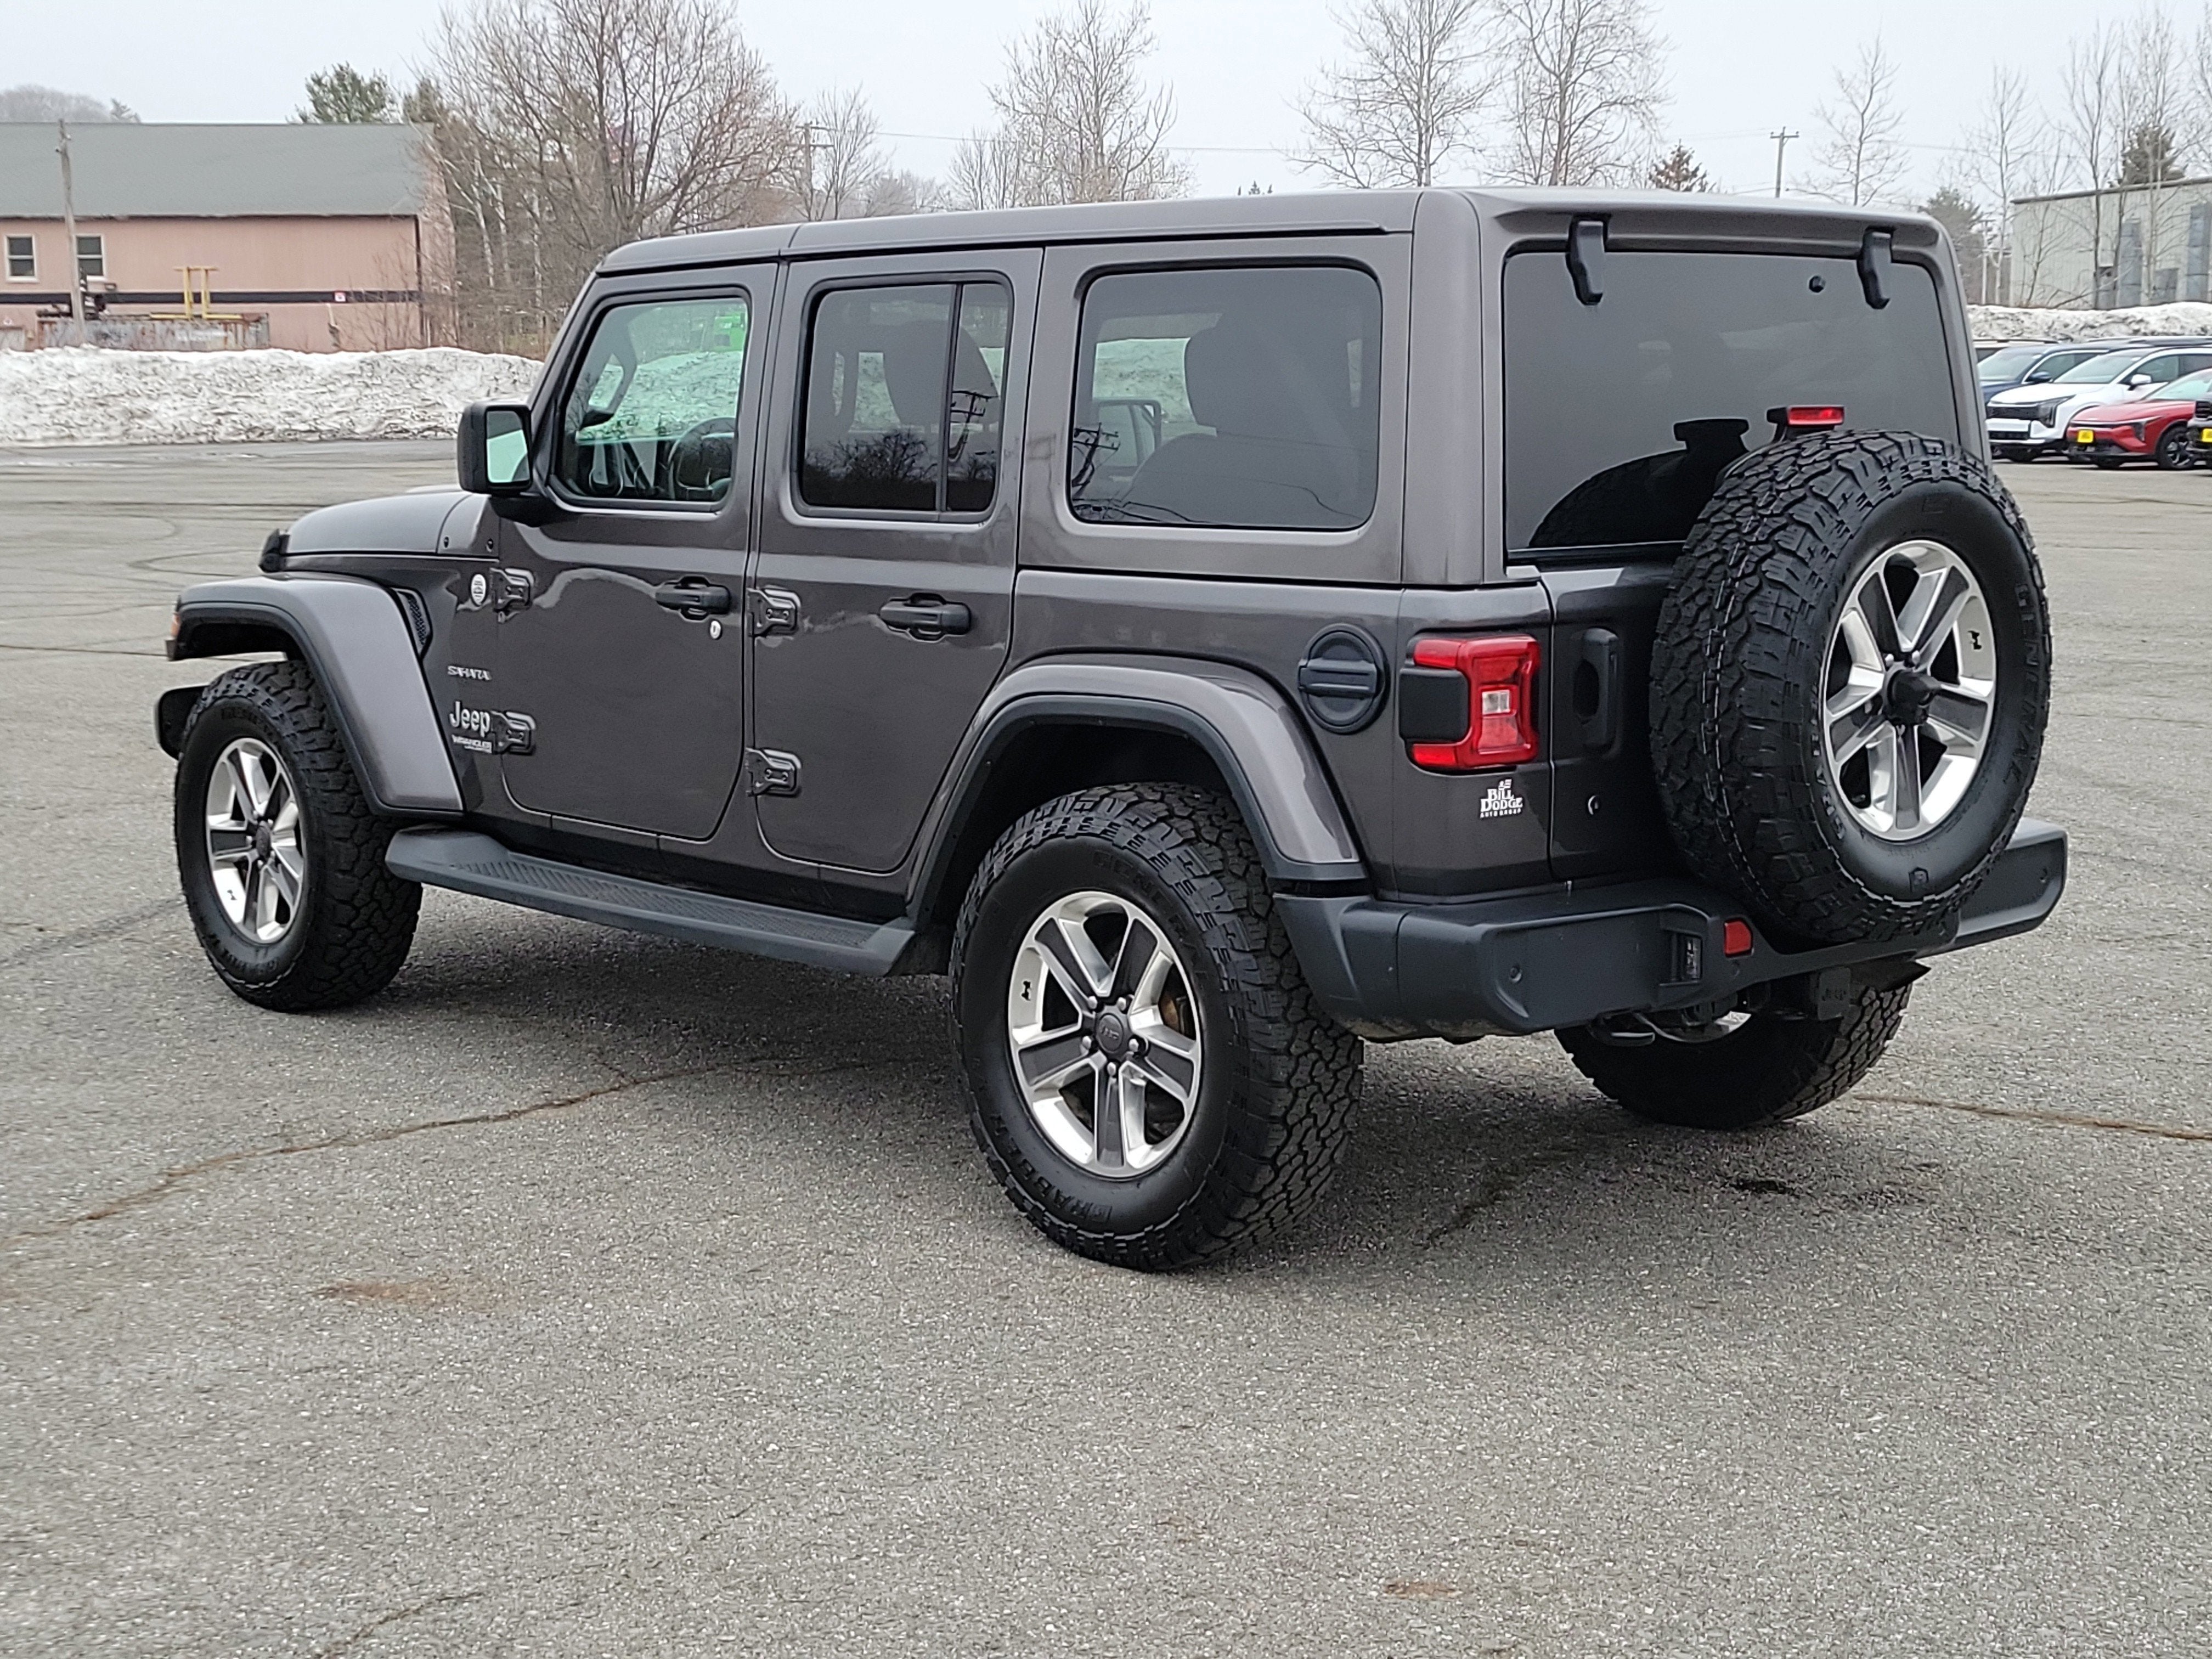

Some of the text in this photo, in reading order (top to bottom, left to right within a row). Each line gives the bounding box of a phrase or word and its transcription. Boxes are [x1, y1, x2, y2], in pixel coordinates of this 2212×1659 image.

[447, 665, 492, 681] SAHARA
[450, 701, 490, 738] Jeep
[1487, 788, 1514, 800] BILL
[1480, 798, 1523, 811] DODGE
